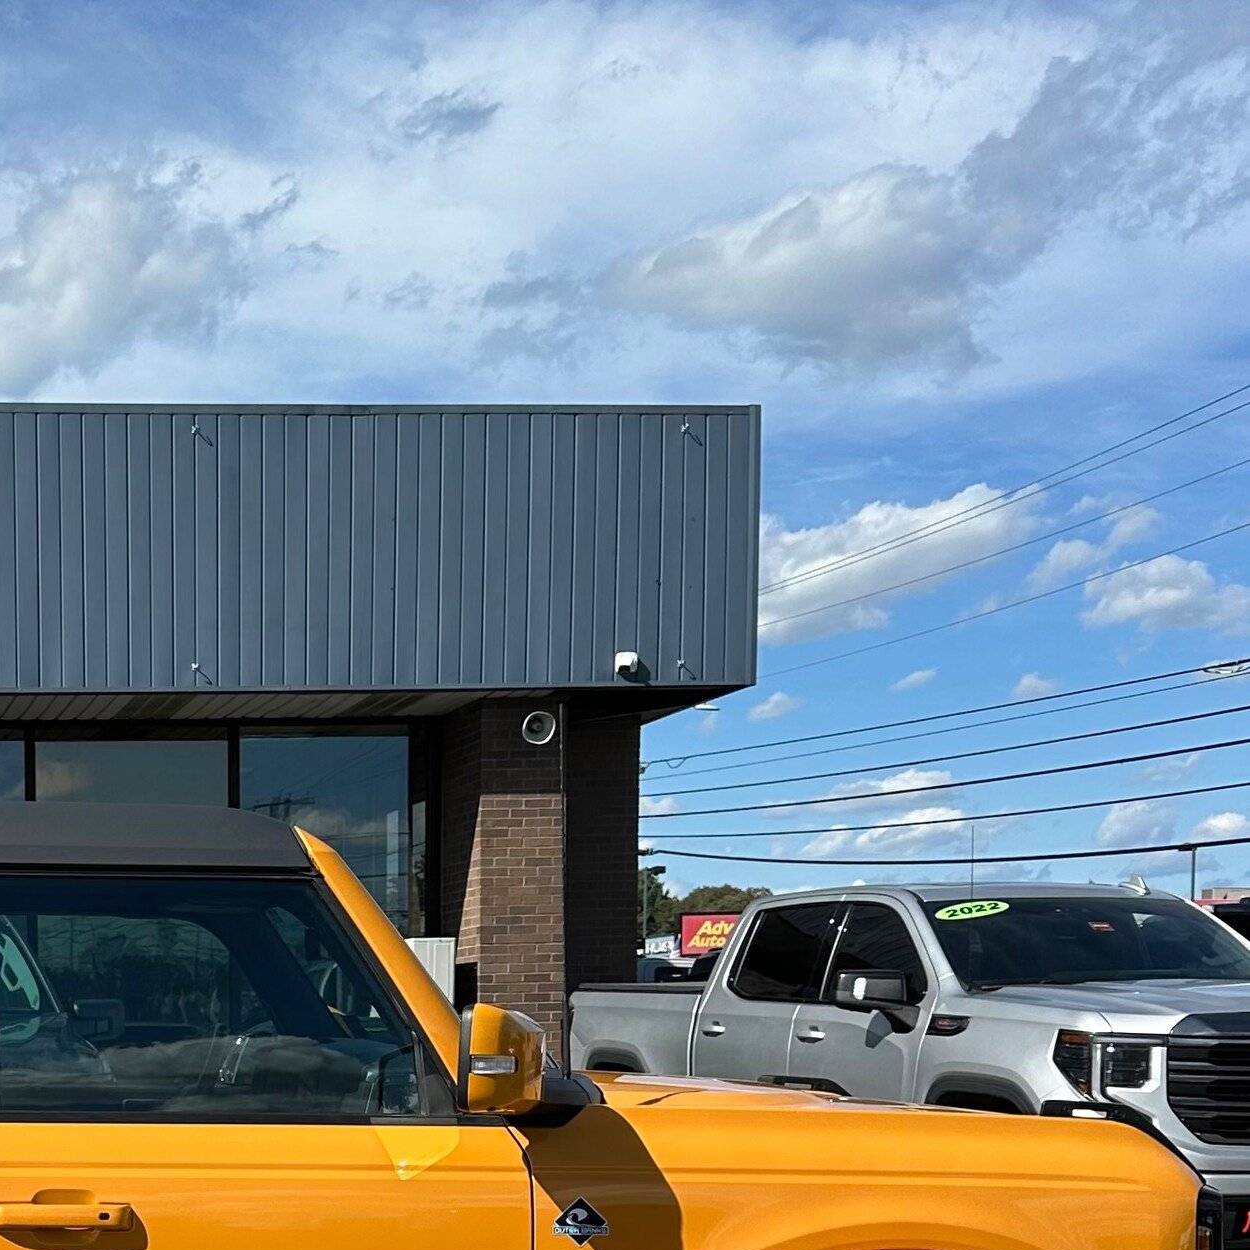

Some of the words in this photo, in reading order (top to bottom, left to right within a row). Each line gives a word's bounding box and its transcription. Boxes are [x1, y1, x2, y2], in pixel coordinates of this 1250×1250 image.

[945, 902, 1001, 918] 2022
[697, 920, 735, 935] Adv
[687, 935, 726, 947] Auto
